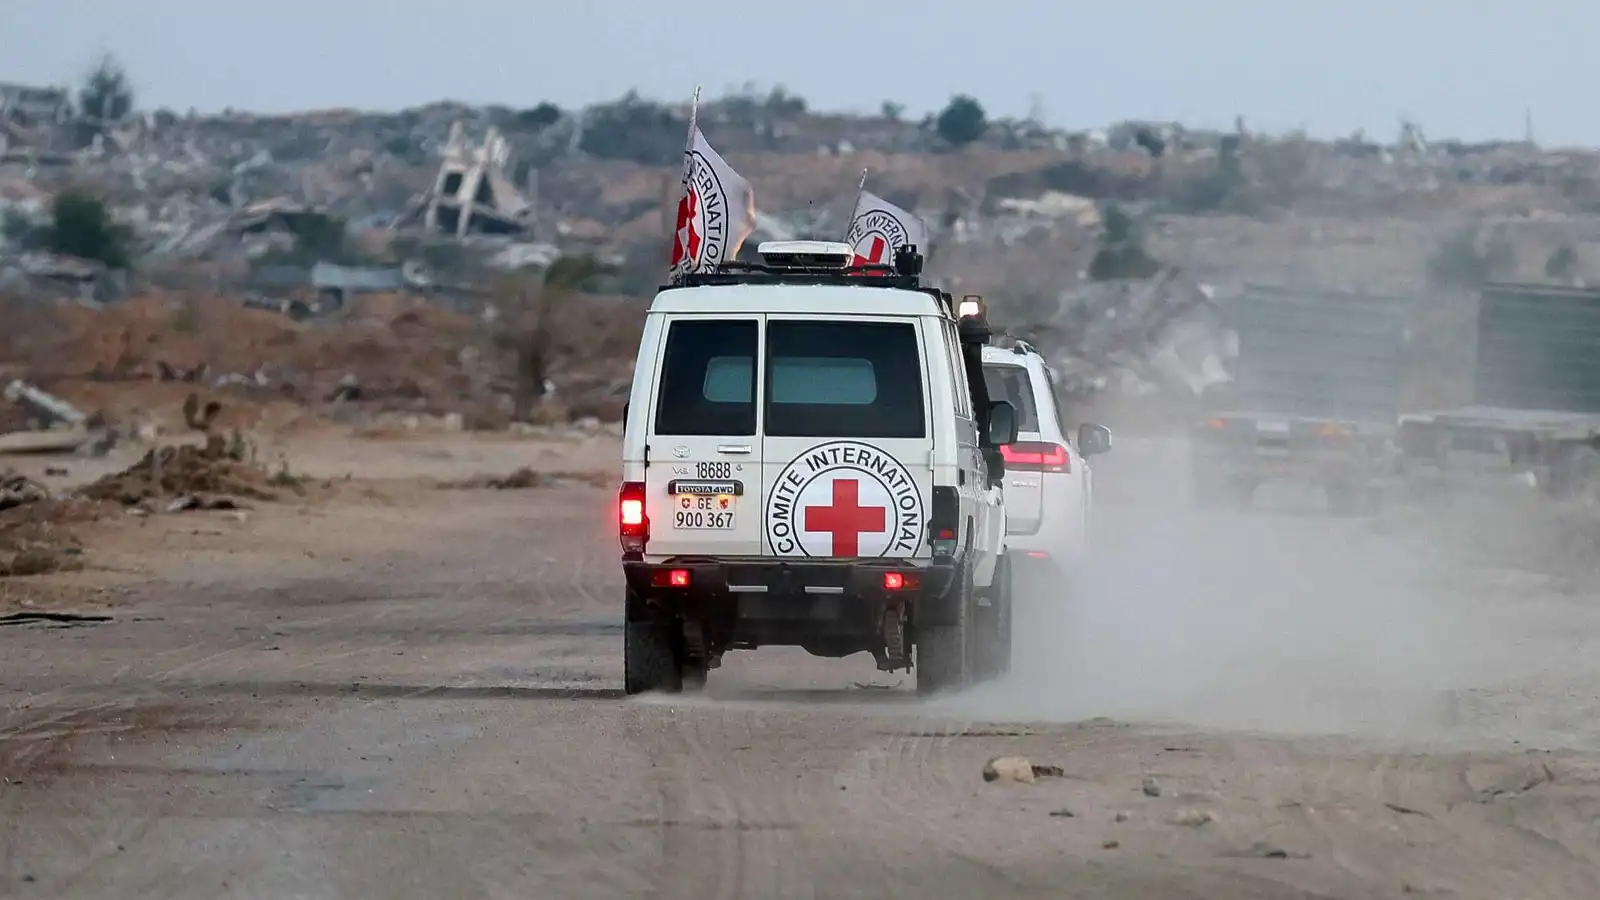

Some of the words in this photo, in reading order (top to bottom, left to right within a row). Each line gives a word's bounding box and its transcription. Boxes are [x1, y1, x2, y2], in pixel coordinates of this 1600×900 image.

[695, 462, 731, 479] 18688
[678, 485, 712, 493] TOYOTA
[697, 497, 713, 510] GE
[773, 469, 805, 554] COMITE
[805, 447, 918, 552] INTERNATIONAL
[676, 511, 703, 528] 900
[707, 512, 734, 528] 367
